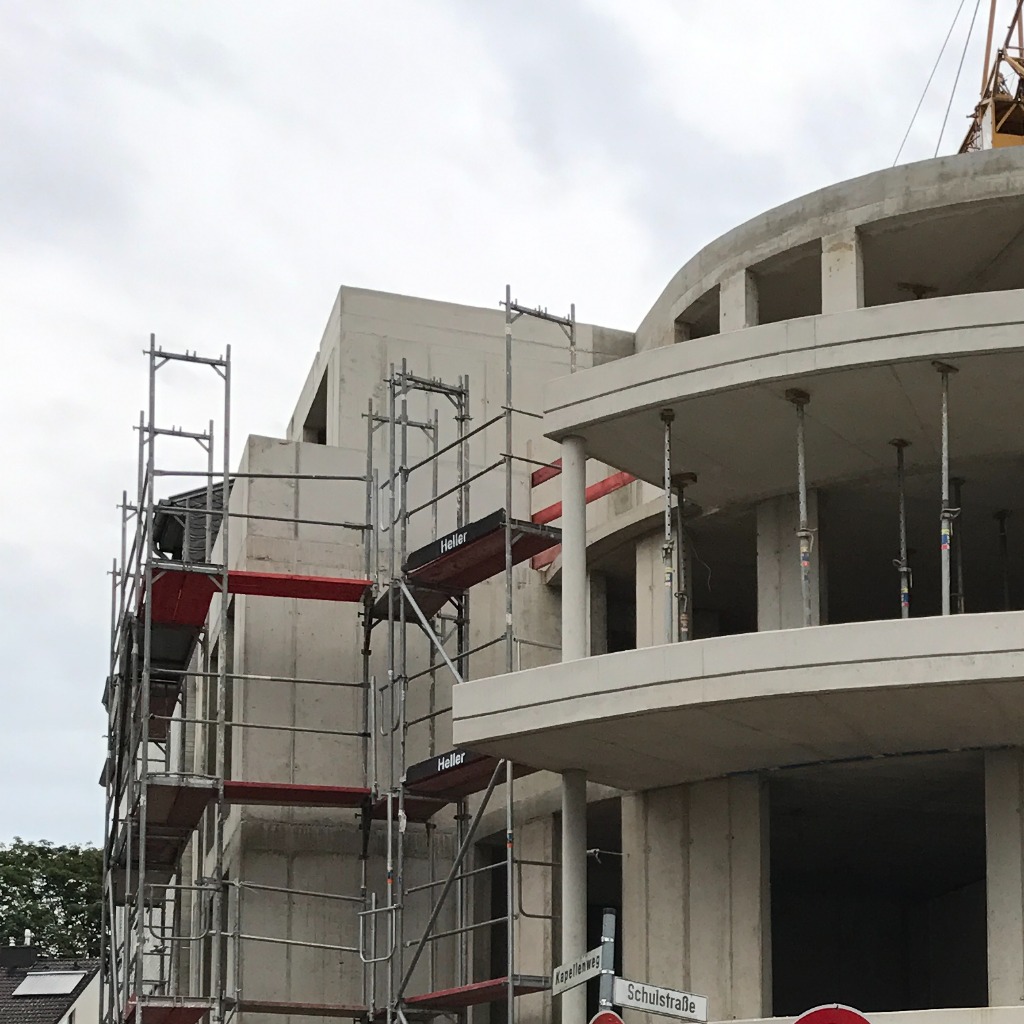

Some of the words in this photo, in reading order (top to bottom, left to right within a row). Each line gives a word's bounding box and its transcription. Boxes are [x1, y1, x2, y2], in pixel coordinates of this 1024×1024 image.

[440, 531, 467, 553] Heller
[437, 752, 466, 771] Heller
[555, 955, 600, 985] Kapellenweg
[627, 983, 696, 1014] Schulstraße
